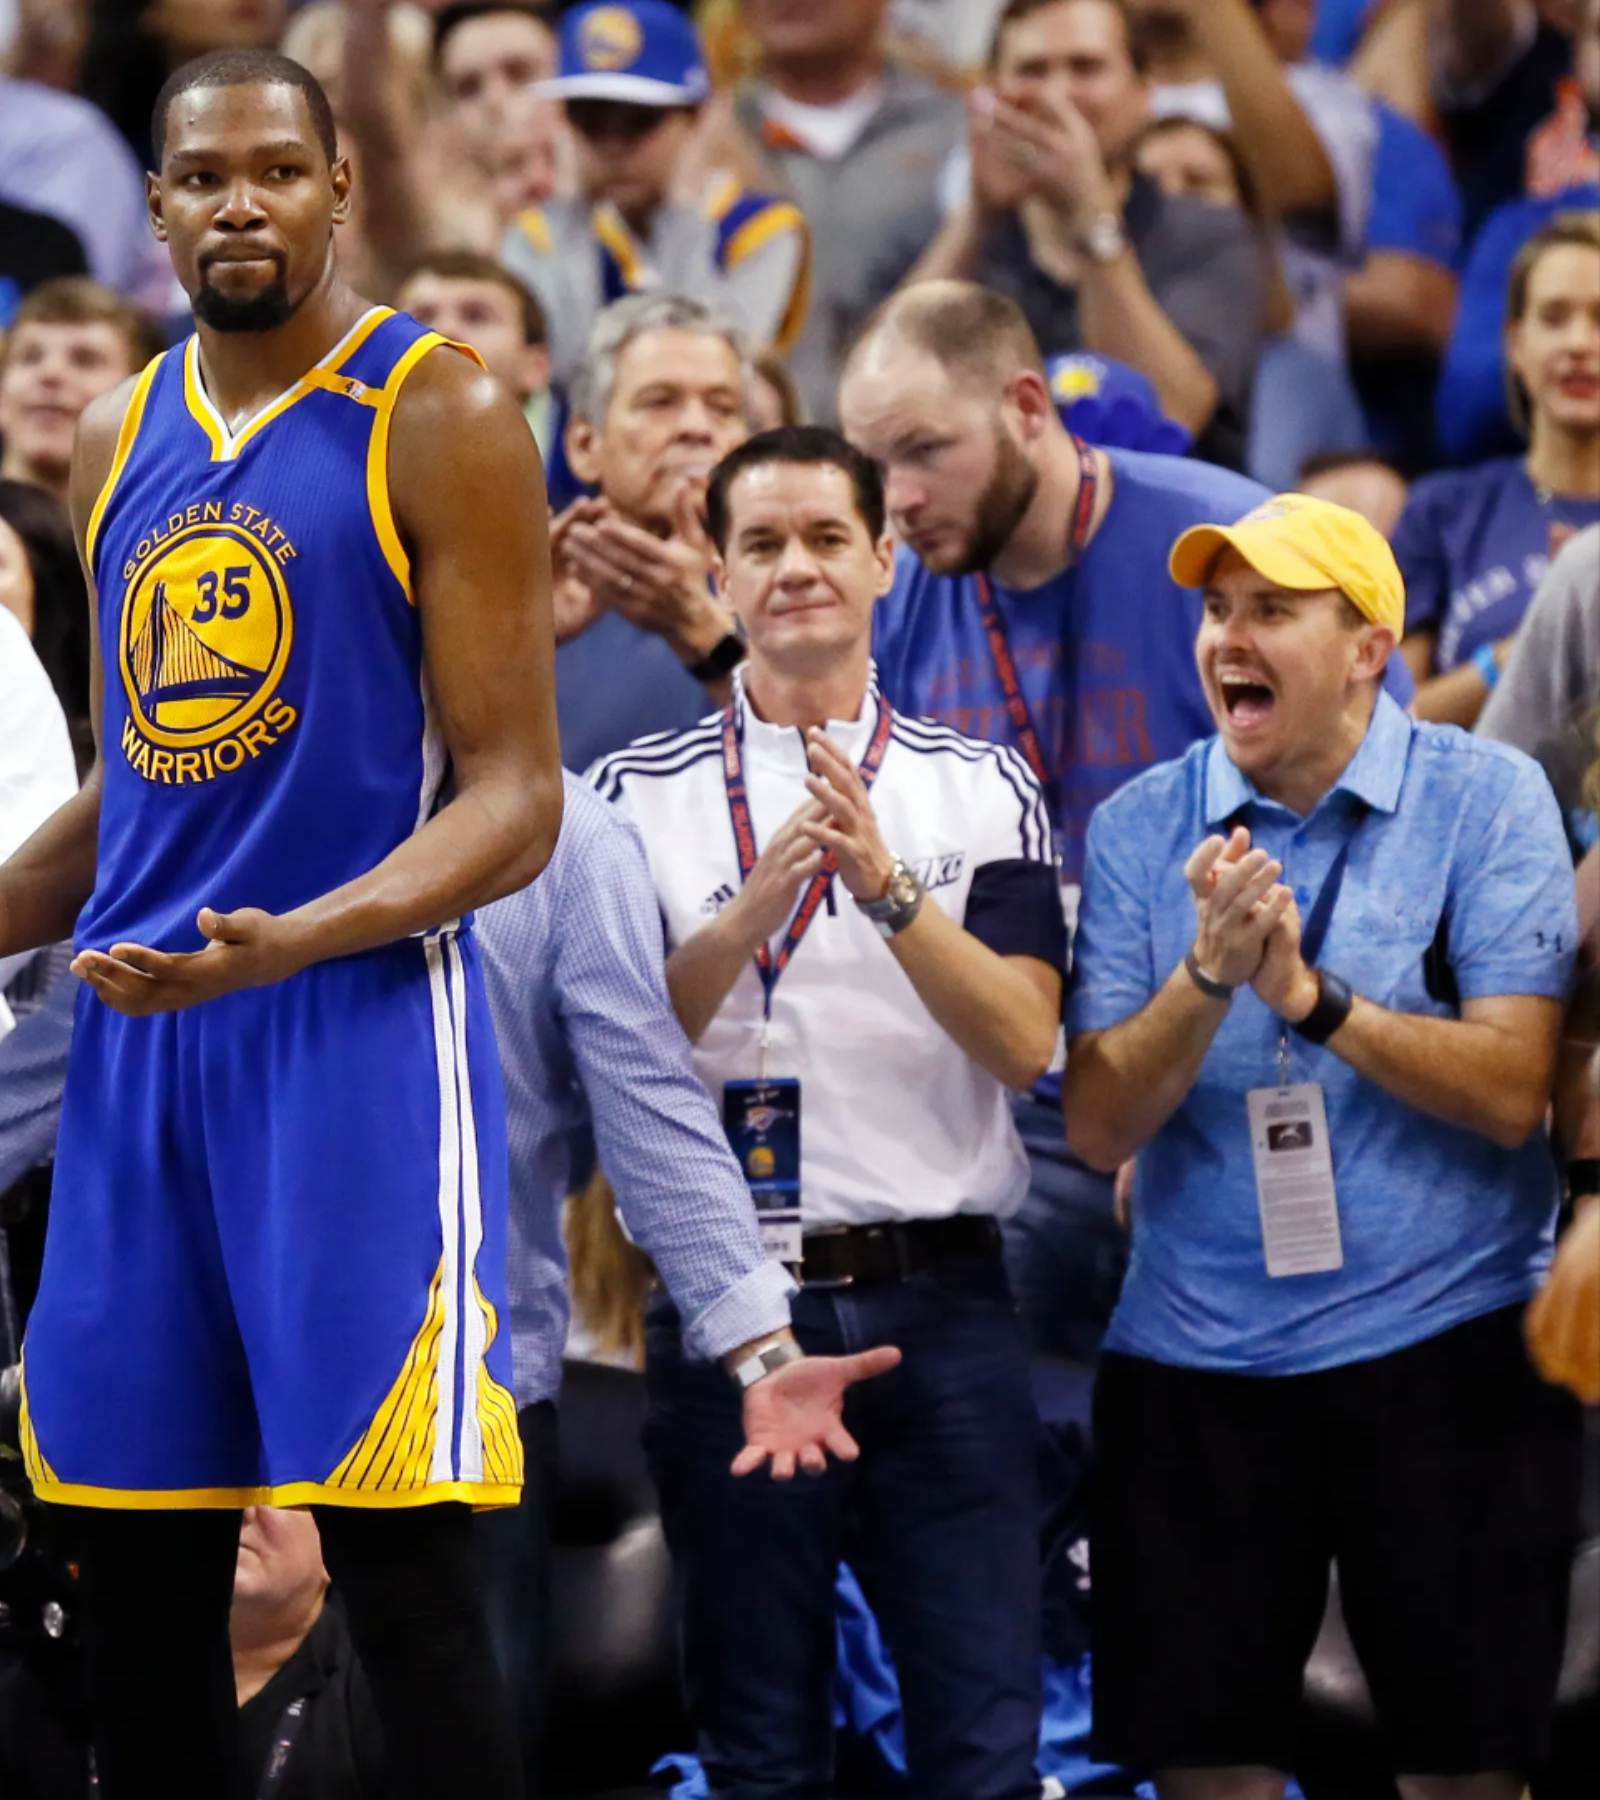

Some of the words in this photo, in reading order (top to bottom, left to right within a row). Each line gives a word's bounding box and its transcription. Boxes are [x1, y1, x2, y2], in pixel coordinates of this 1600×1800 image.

[122, 501, 223, 580] GOLDEN
[229, 503, 298, 566] STATE
[191, 564, 252, 624] 35
[121, 698, 298, 784] WARRIORS
